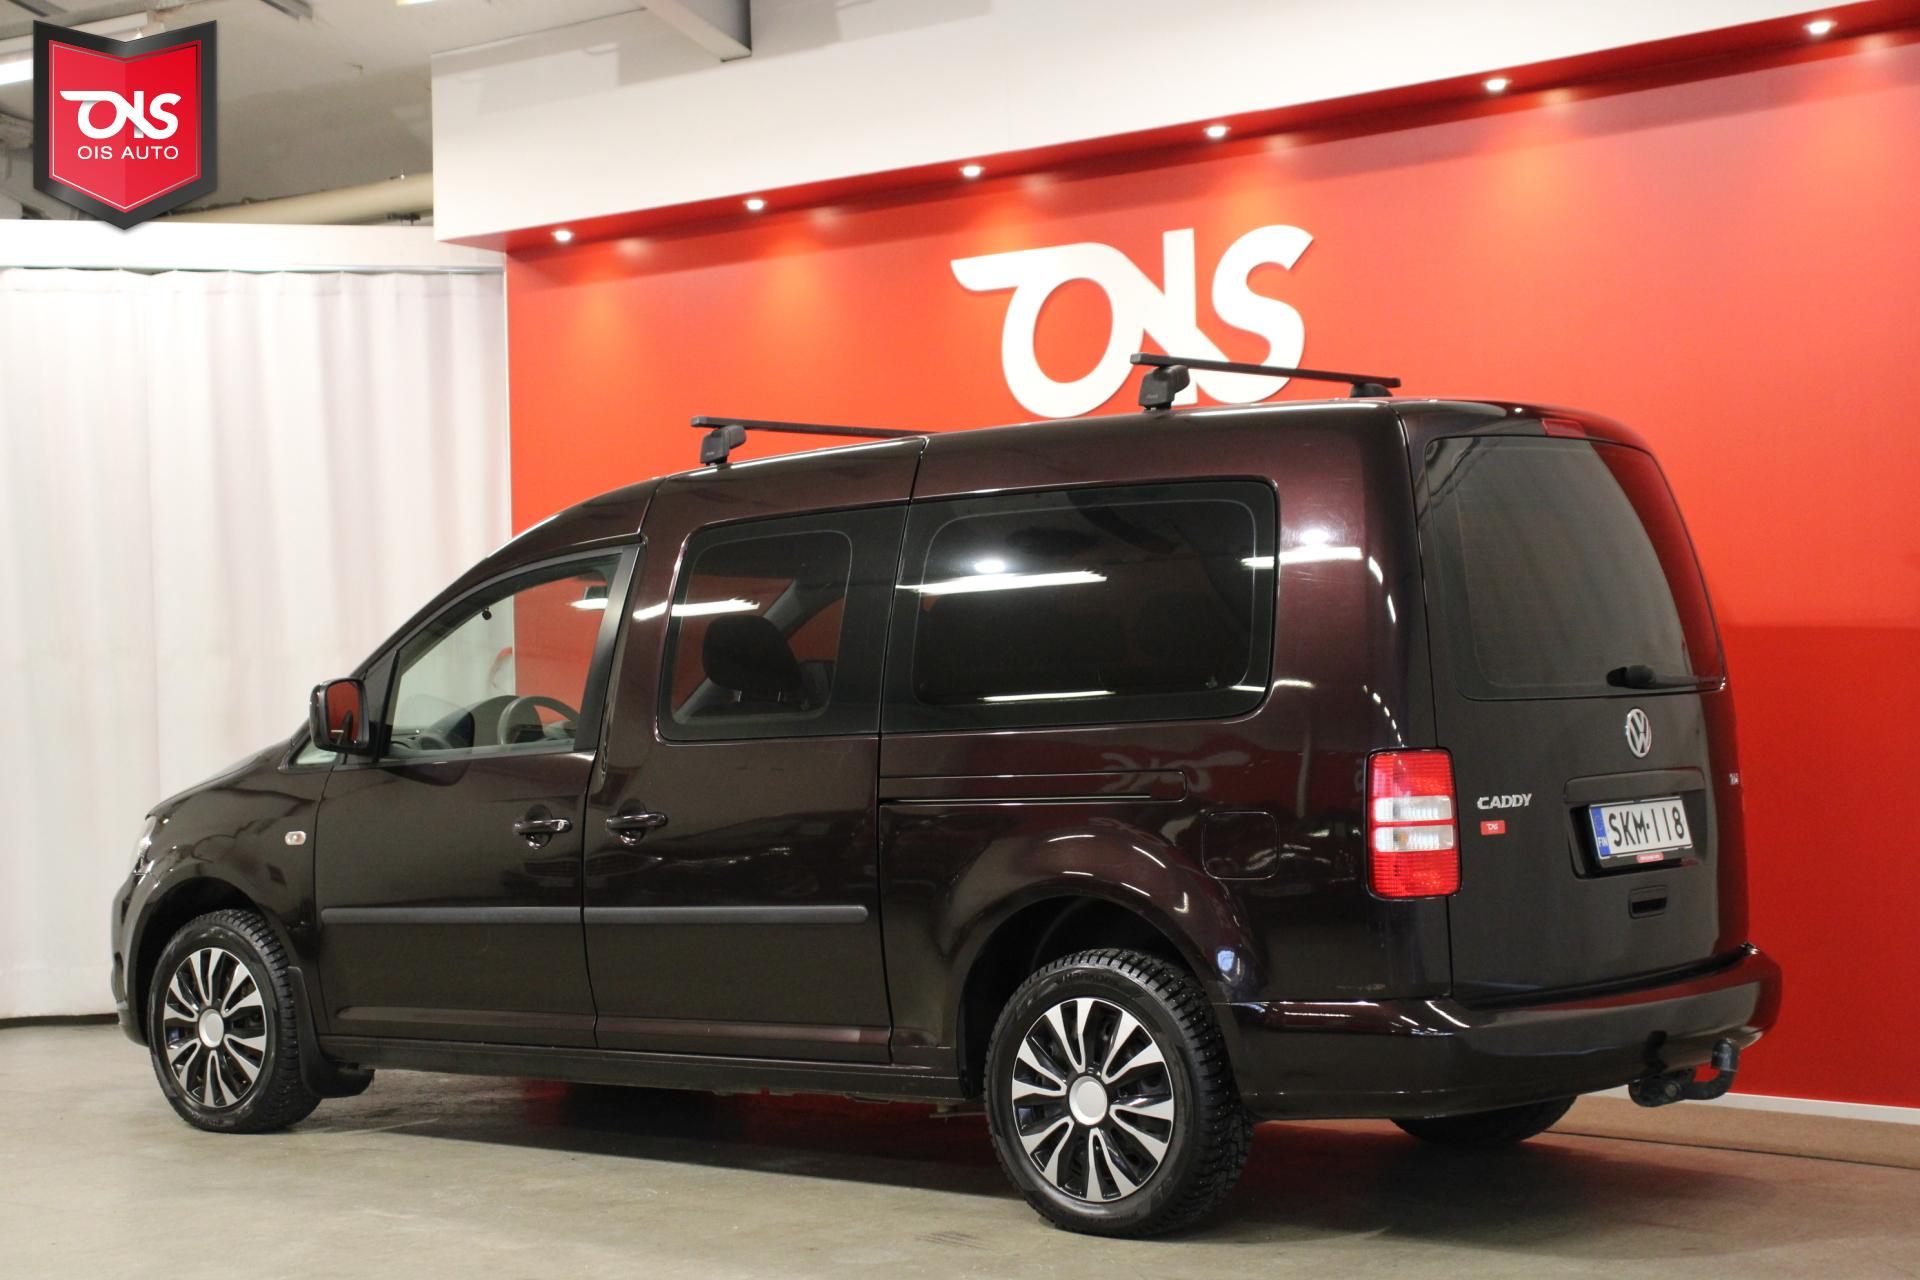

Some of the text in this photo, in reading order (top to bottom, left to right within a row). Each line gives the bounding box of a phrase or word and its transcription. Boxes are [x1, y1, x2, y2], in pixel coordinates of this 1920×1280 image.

[951, 225, 1314, 418] OIS
[1477, 793, 1532, 809] CADDY
[1608, 806, 1684, 847] SKM-118
